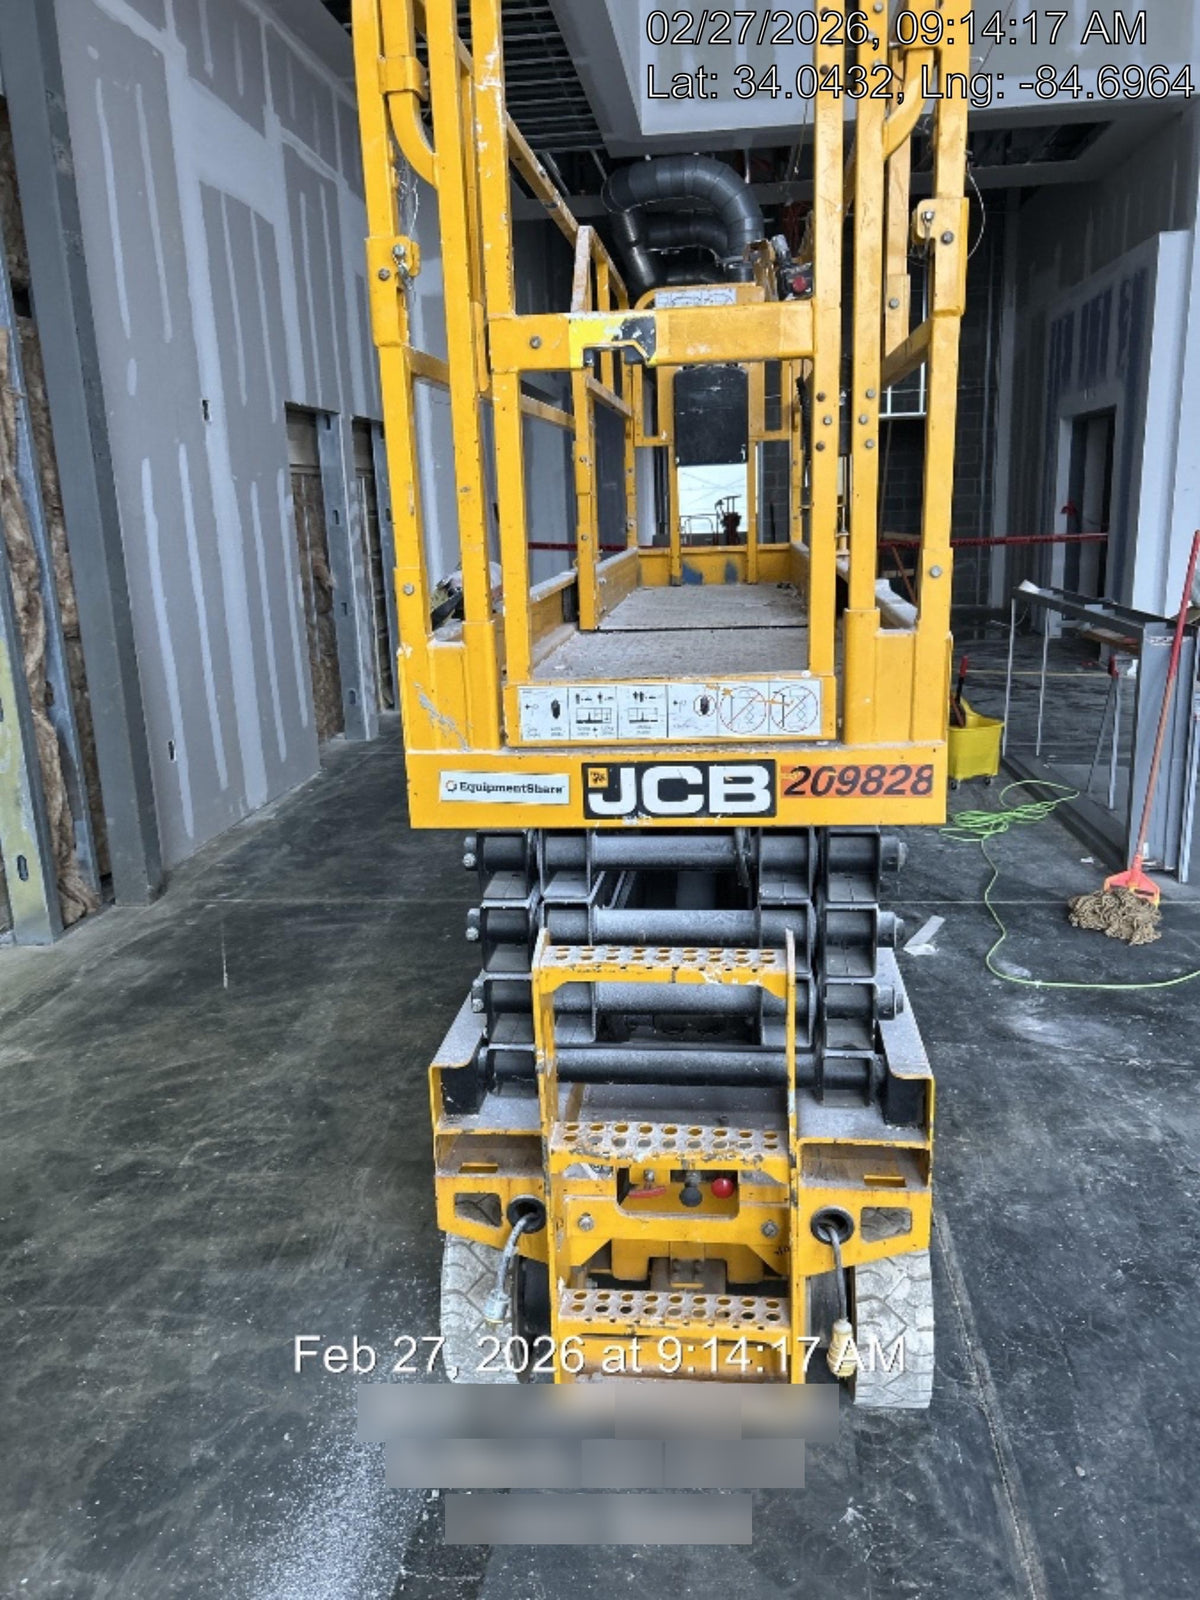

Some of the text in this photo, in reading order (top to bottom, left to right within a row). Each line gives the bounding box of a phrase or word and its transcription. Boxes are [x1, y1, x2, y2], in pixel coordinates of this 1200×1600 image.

[458, 780, 563, 797] EquipmentShare
[588, 765, 771, 816] JCB
[783, 764, 934, 797] 209828
